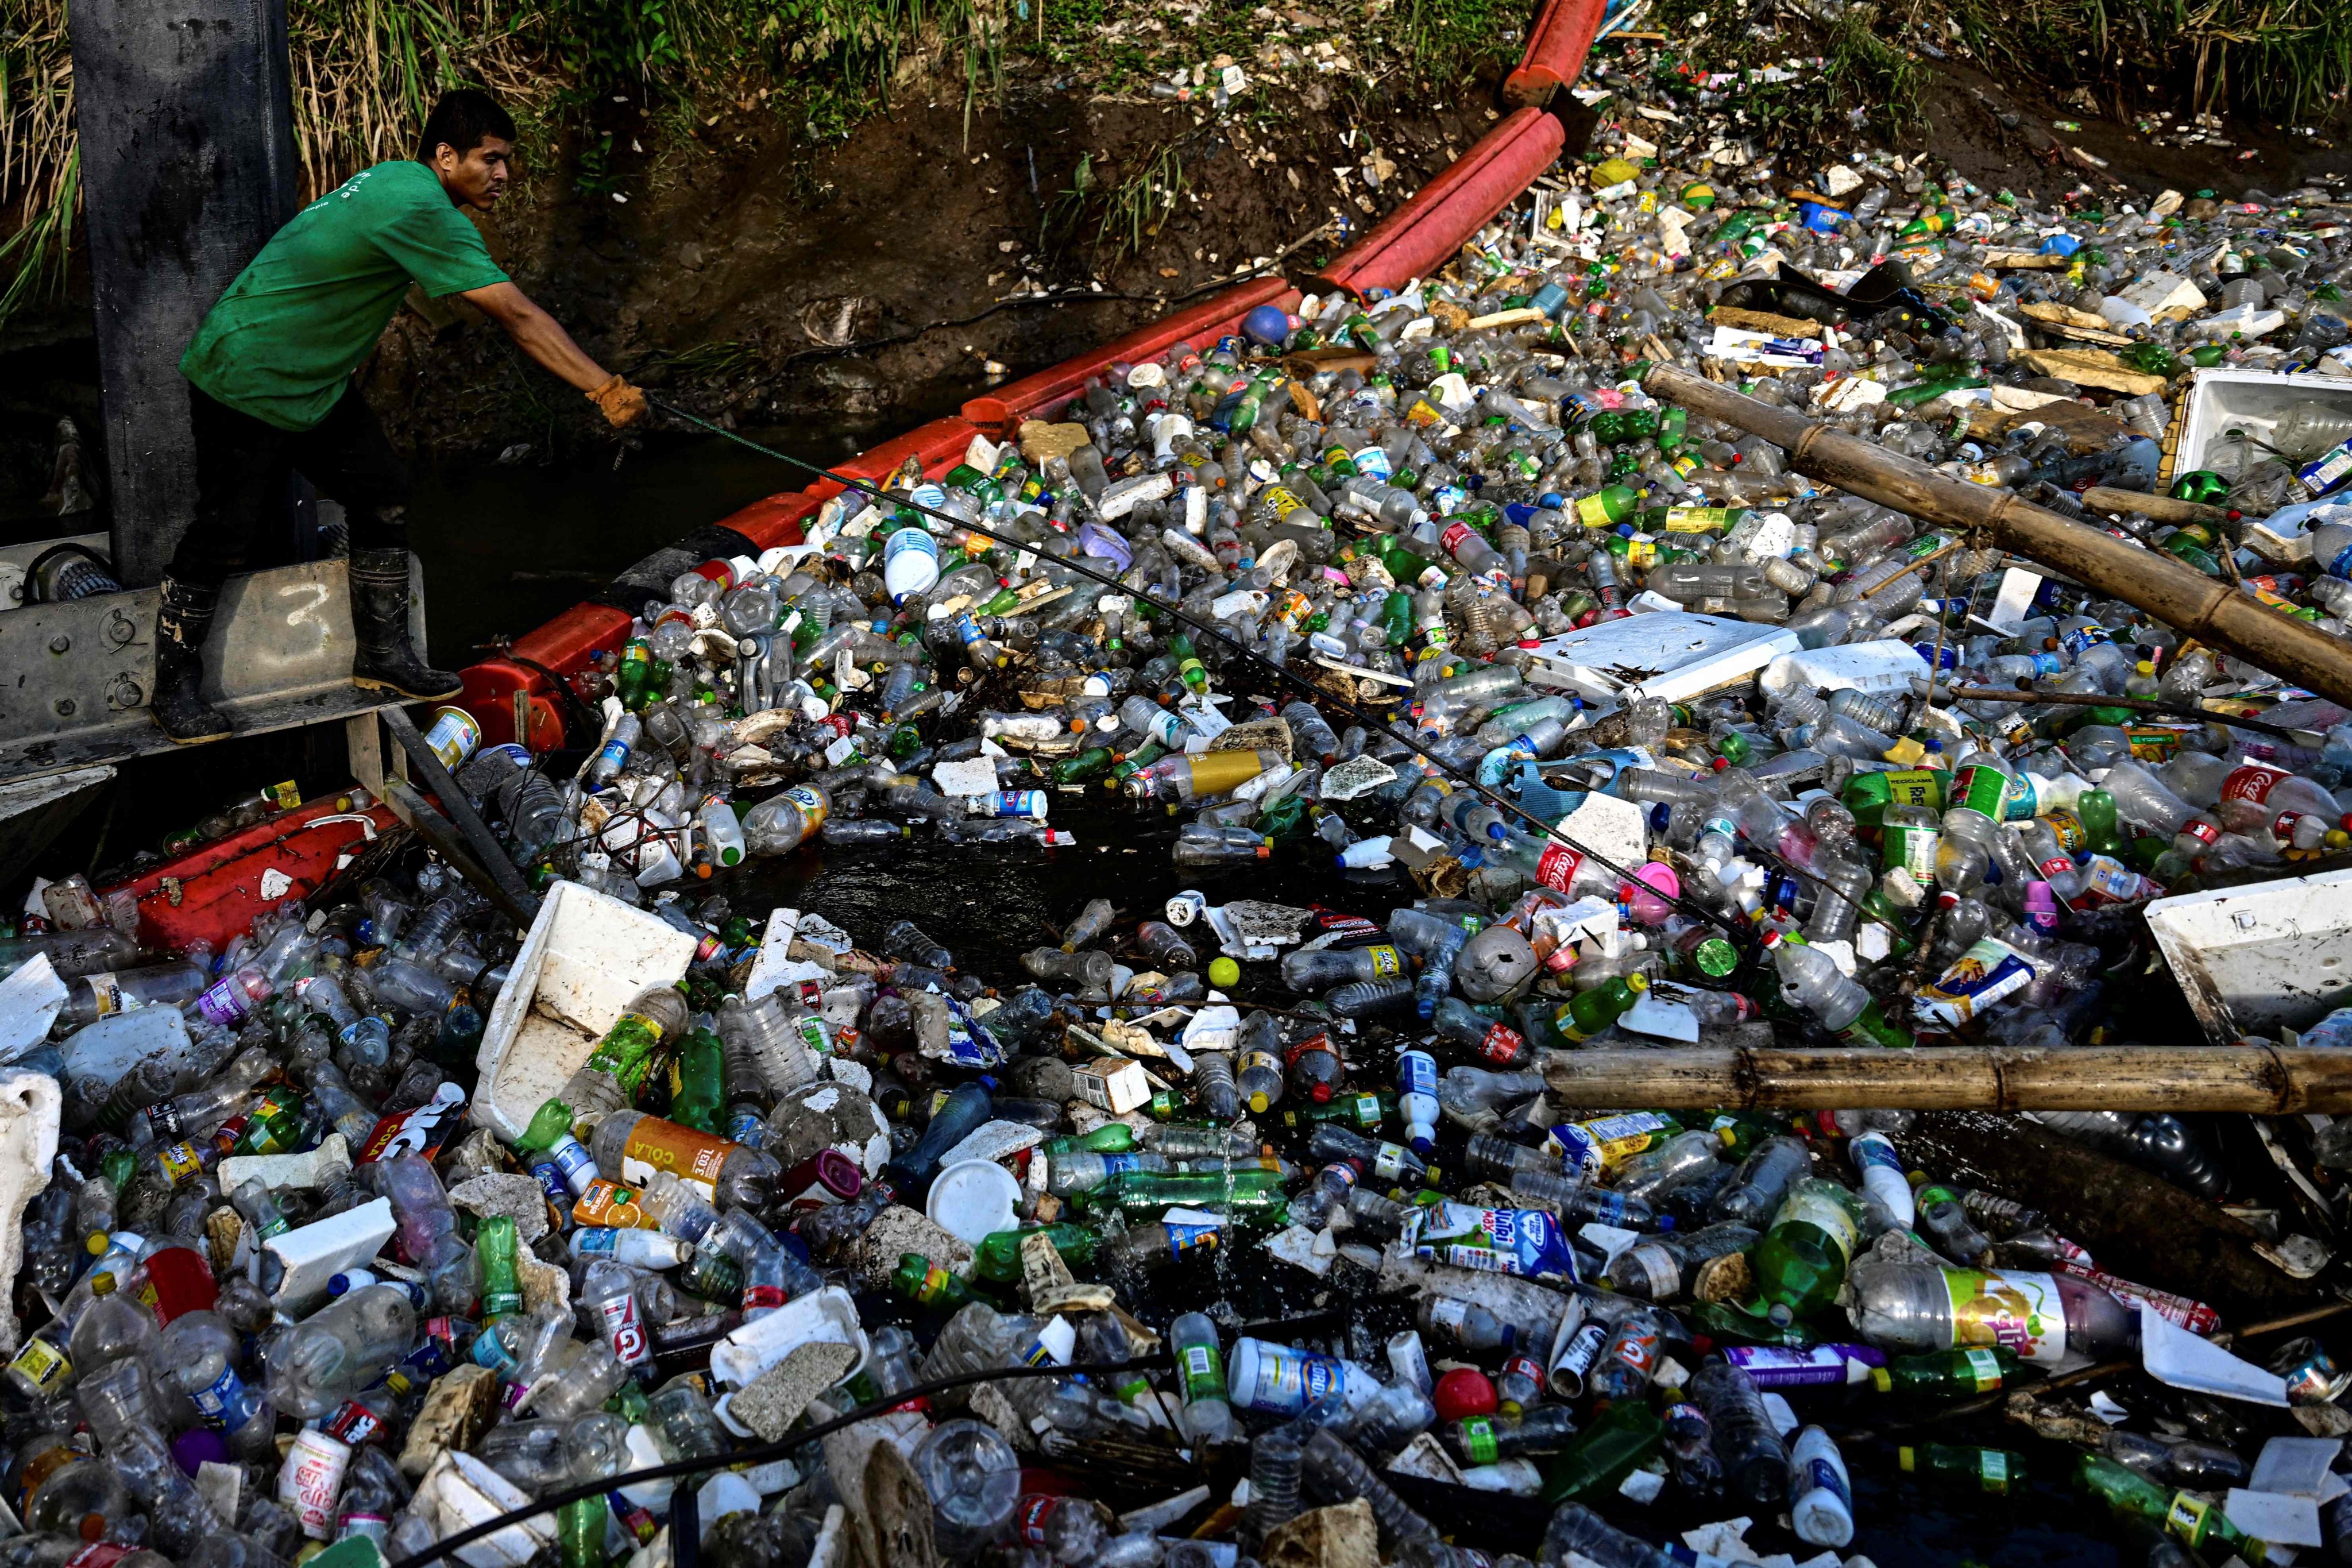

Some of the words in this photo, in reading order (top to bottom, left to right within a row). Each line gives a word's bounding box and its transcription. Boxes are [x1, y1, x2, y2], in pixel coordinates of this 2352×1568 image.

[259, 583, 330, 665] 3
[367, 1124, 397, 1157] COLA
[635, 1141, 674, 1164] COLA
[589, 1184, 613, 1215] Naranja
[1534, 1212, 1546, 1246] ESTRELLA
[619, 1328, 642, 1356] G
[344, 1415, 377, 1445] BIG
